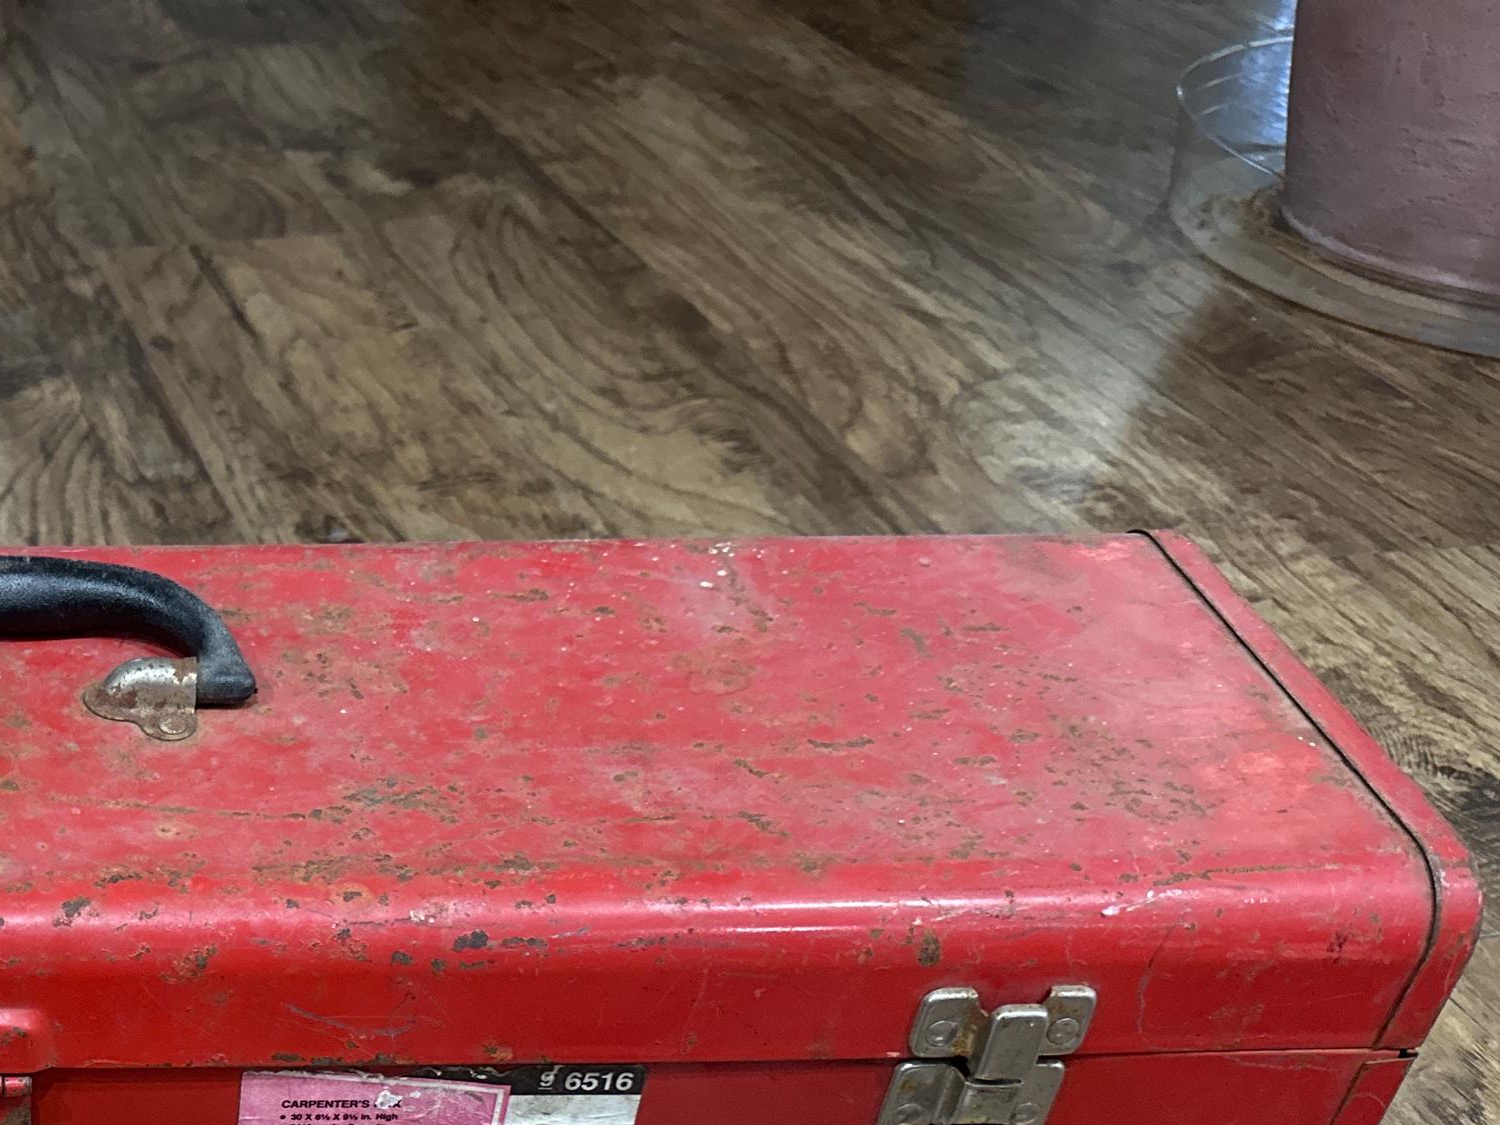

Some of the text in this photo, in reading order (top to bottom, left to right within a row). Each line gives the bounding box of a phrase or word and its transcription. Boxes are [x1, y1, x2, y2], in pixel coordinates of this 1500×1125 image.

[564, 1072, 635, 1091] 6516
[281, 1099, 370, 1109] CARPENTER'S
[290, 1113, 302, 1121] 30
[305, 1113, 312, 1121] X
[333, 1113, 340, 1121] X
[375, 1113, 398, 1122] High
